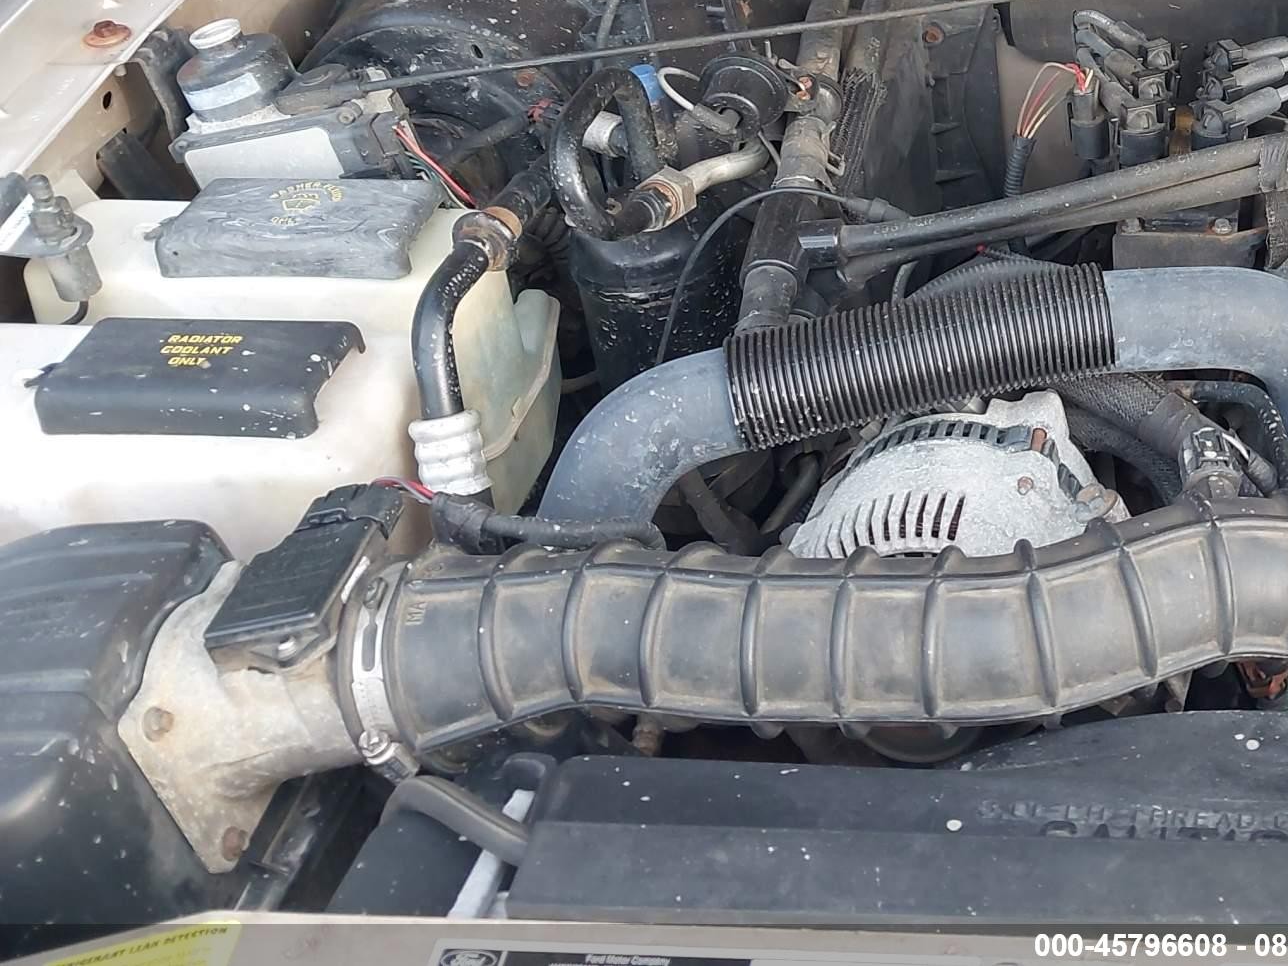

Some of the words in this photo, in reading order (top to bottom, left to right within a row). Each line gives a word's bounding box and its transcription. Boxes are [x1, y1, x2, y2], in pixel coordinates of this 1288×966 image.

[167, 334, 243, 344] RADIATOR
[160, 345, 234, 355] COOLANT
[167, 356, 207, 368] ONLY
[163, 927, 229, 944] DETECTION
[583, 953, 605, 965] Ford
